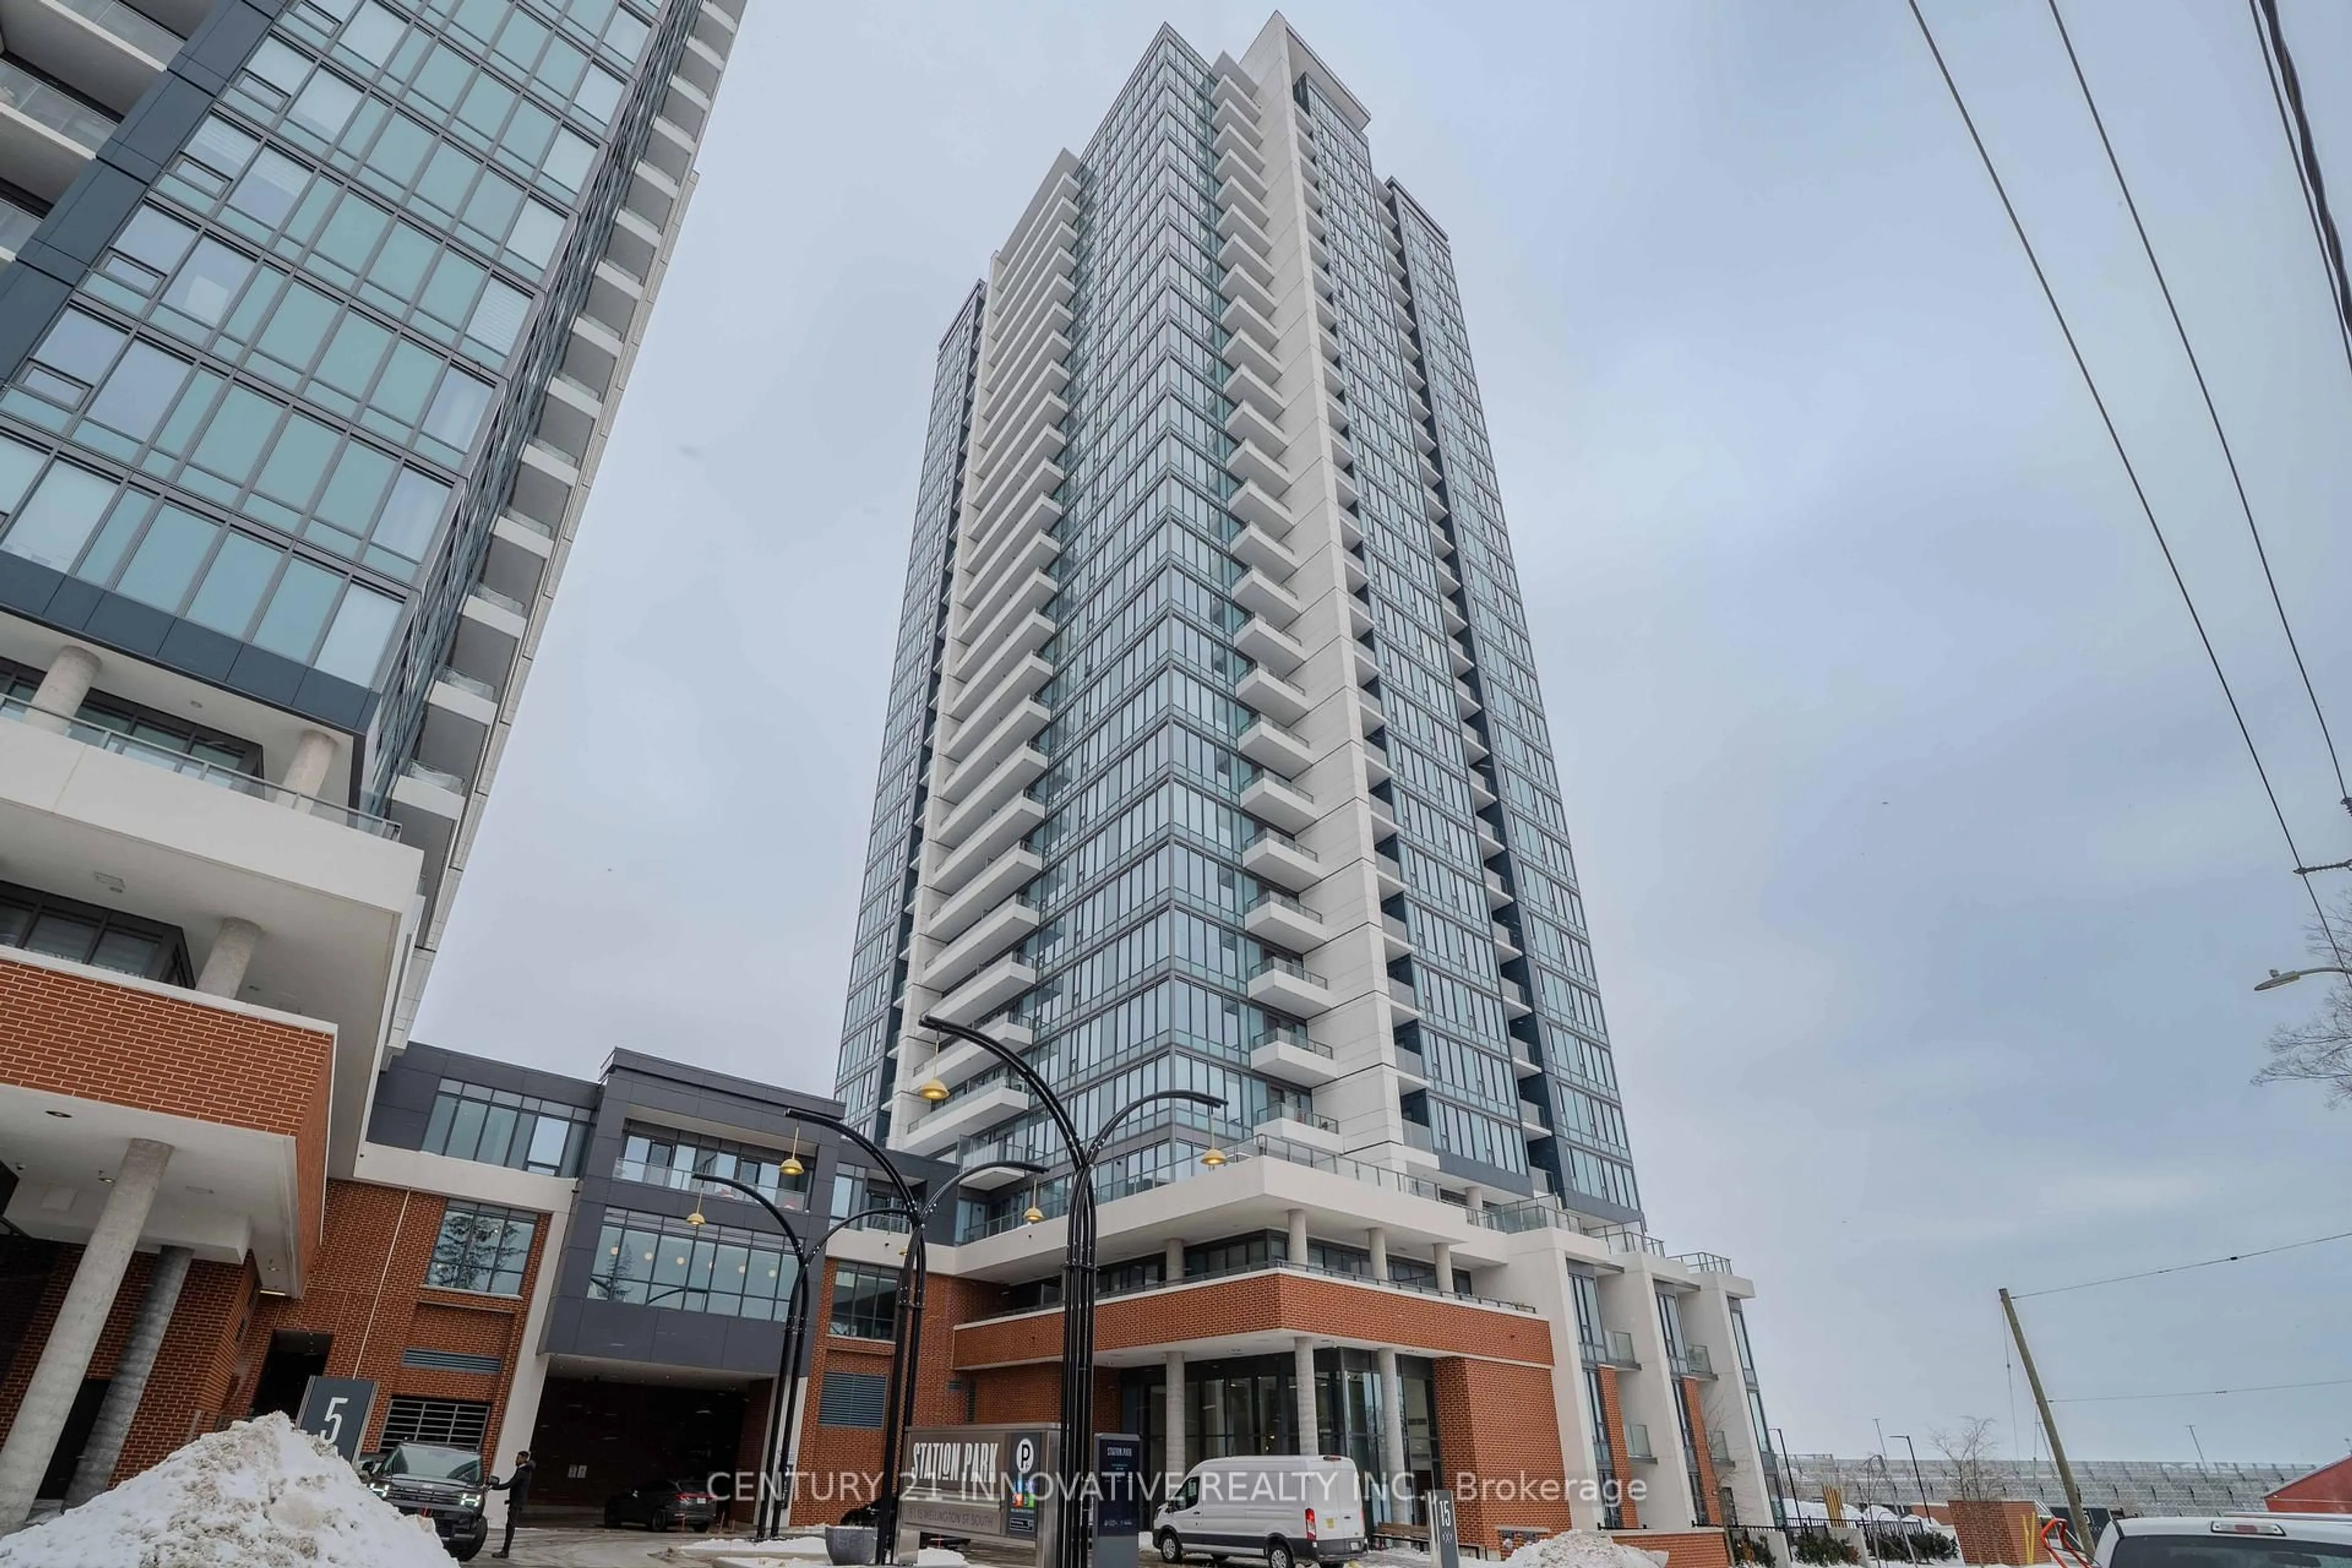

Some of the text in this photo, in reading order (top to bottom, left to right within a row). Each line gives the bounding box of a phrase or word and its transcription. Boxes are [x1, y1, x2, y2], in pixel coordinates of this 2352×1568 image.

[320, 1396, 349, 1444] 5
[911, 1442, 1000, 1483] STATION PARK
[924, 1509, 961, 1524] WELLINGTON
[971, 1513, 993, 1528] SOUTH
[1439, 1500, 1451, 1527] 15
